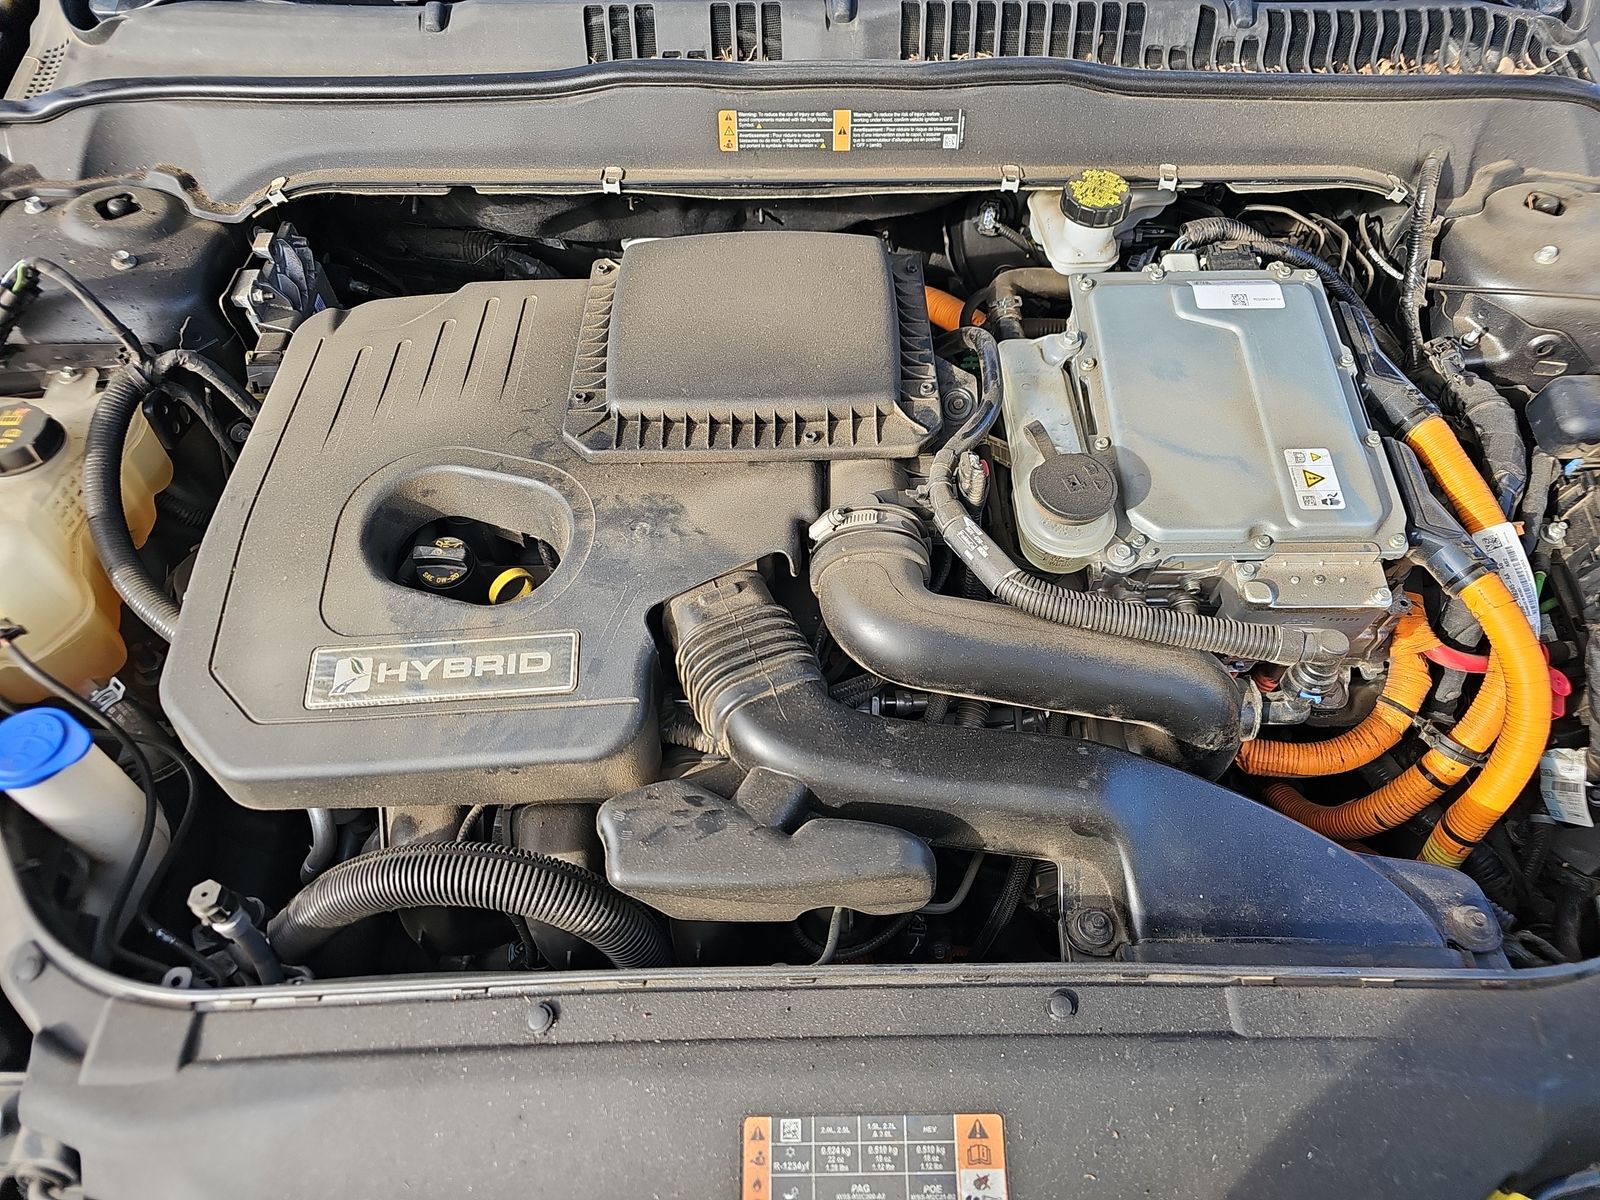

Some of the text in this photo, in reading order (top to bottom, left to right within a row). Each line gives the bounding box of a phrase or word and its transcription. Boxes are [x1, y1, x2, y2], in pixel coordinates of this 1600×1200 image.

[376, 652, 552, 683] HYBRID
[841, 1146, 851, 1157] kg
[888, 1145, 898, 1156] kg
[936, 1144, 946, 1156] kg
[773, 1161, 810, 1172] R-1234yf
[850, 1184, 870, 1193] PAG
[923, 1184, 943, 1194] POE
